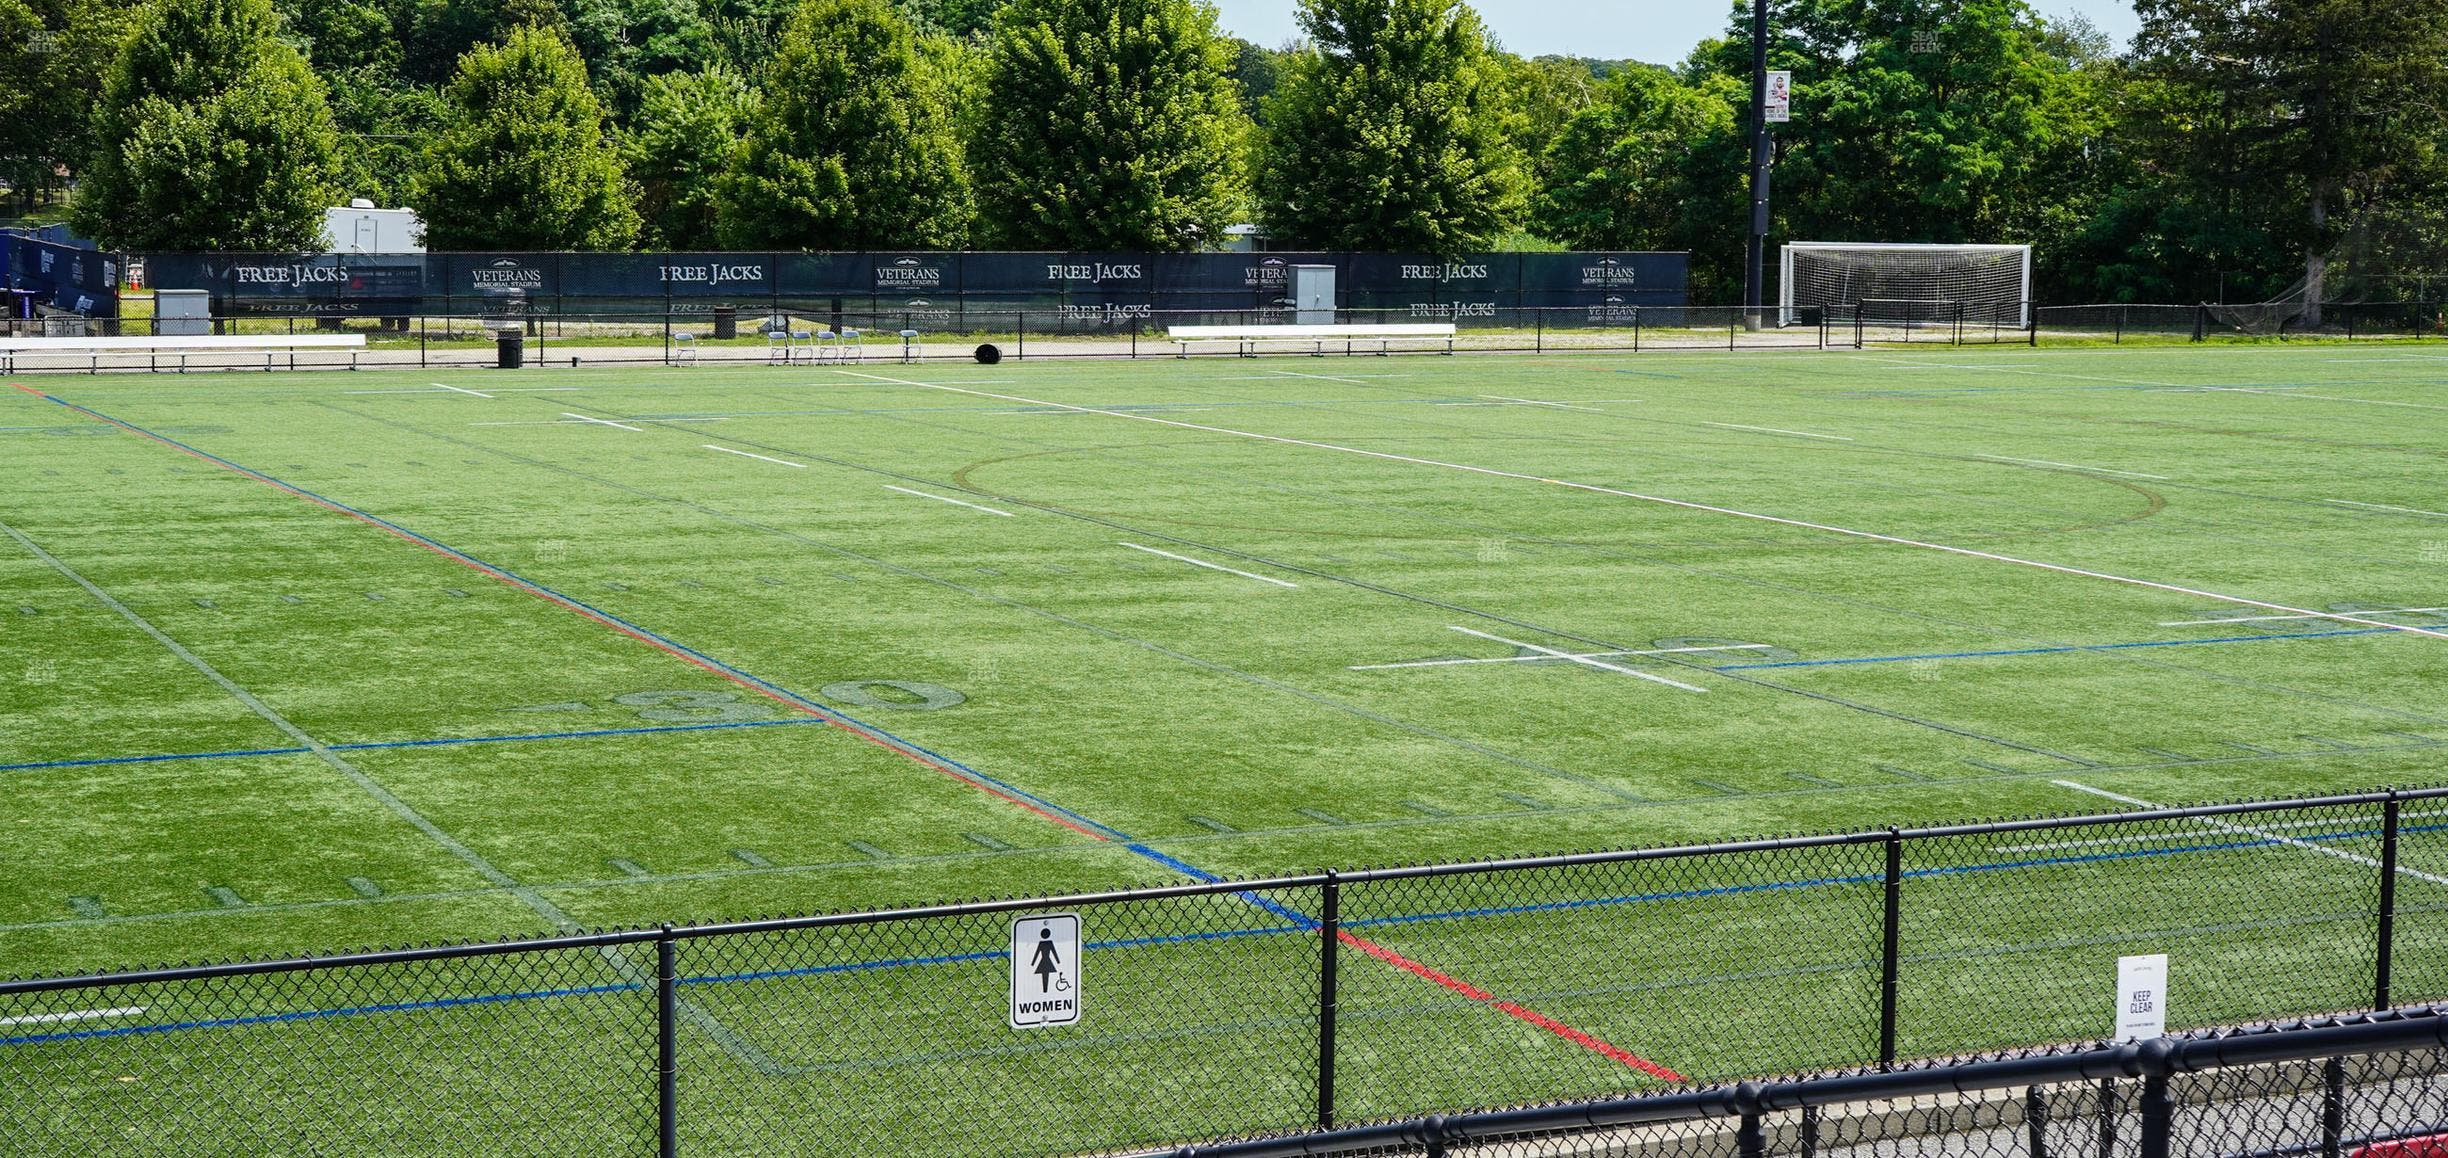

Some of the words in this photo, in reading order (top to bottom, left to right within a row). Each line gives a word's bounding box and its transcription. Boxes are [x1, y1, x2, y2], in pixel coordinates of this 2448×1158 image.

[236, 266, 290, 282] FREE
[291, 264, 349, 287] JACKS
[472, 269, 541, 281] VETERANS
[659, 265, 708, 281] FREE
[709, 263, 763, 285] JACKS
[876, 268, 939, 279] VETERANS
[1047, 264, 1092, 279] FREE
[1093, 262, 1141, 283] JACKS
[1245, 267, 1288, 278] VETERA
[1401, 264, 1441, 278] FREE
[1442, 263, 1487, 283] JACKS
[1582, 267, 1635, 278] VETERANS
[1058, 305, 1102, 319] FREE
[1103, 302, 1151, 323] JACKS
[1452, 301, 1495, 321] JACKS
[2132, 990, 2151, 1002] KEEP
[1018, 999, 1072, 1014] WOMEN
[2130, 1001, 2153, 1014] CLEAR
